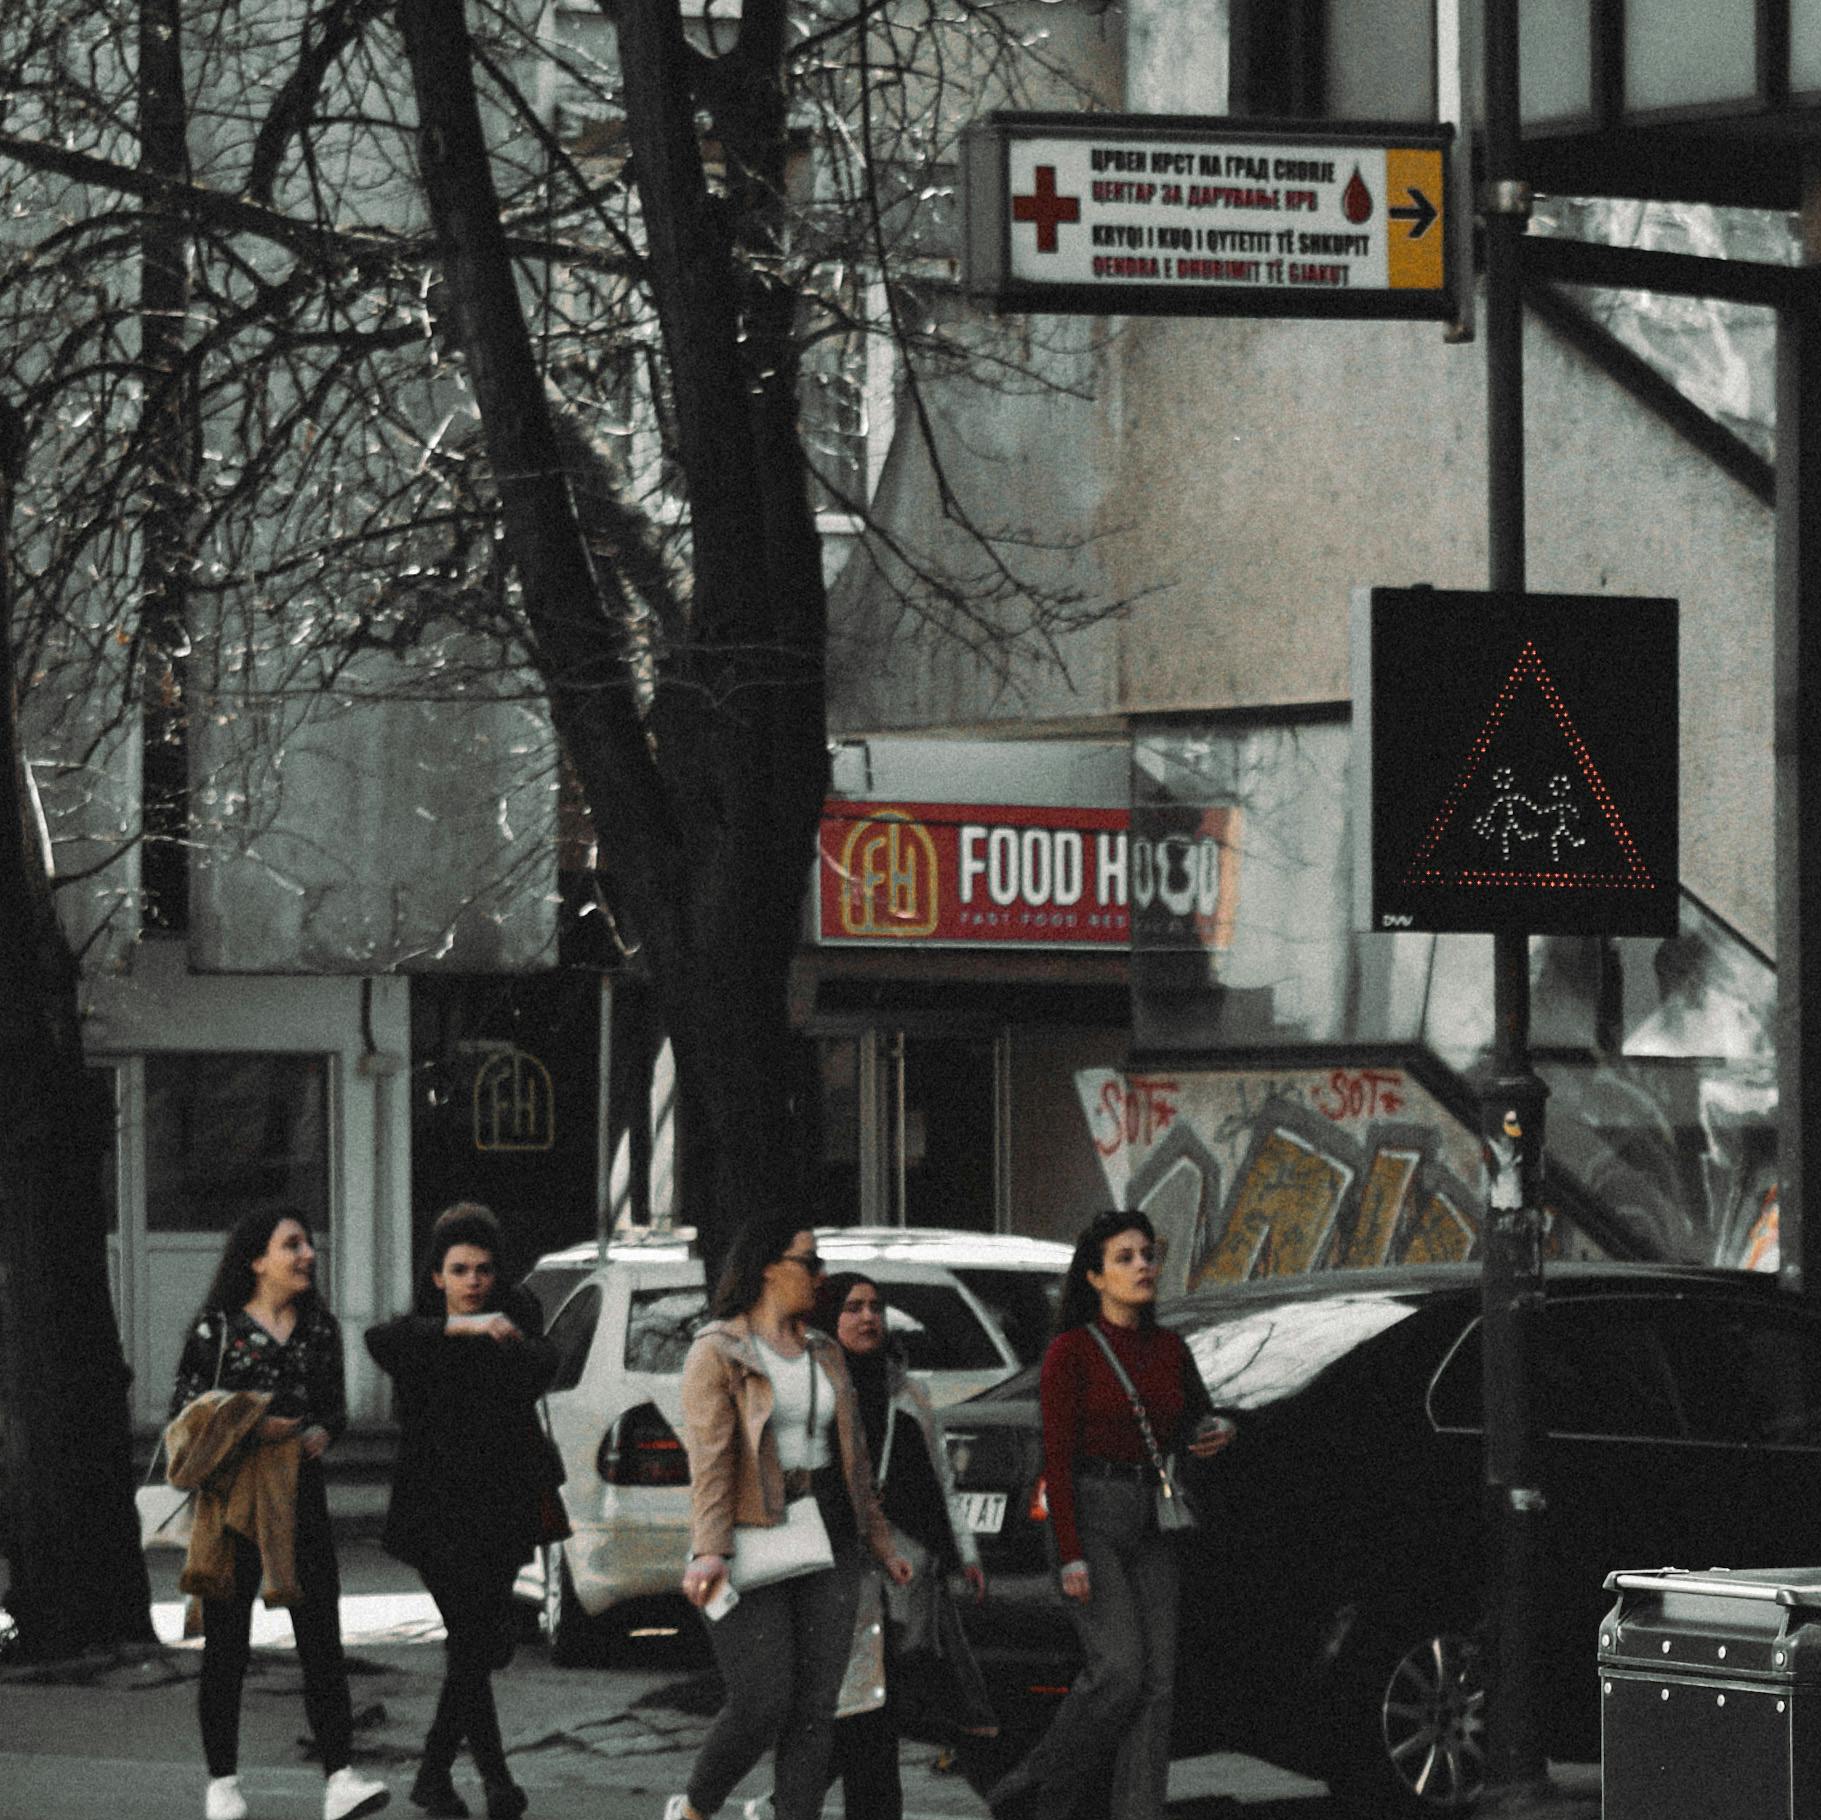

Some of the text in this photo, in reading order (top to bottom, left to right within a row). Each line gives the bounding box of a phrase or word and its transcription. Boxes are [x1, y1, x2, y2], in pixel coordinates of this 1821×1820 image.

[1199, 155, 1222, 177] НА
[1160, 184, 1183, 206] ЗА
[1163, 257, 1173, 279] E
[959, 825, 1084, 907] FOOD
